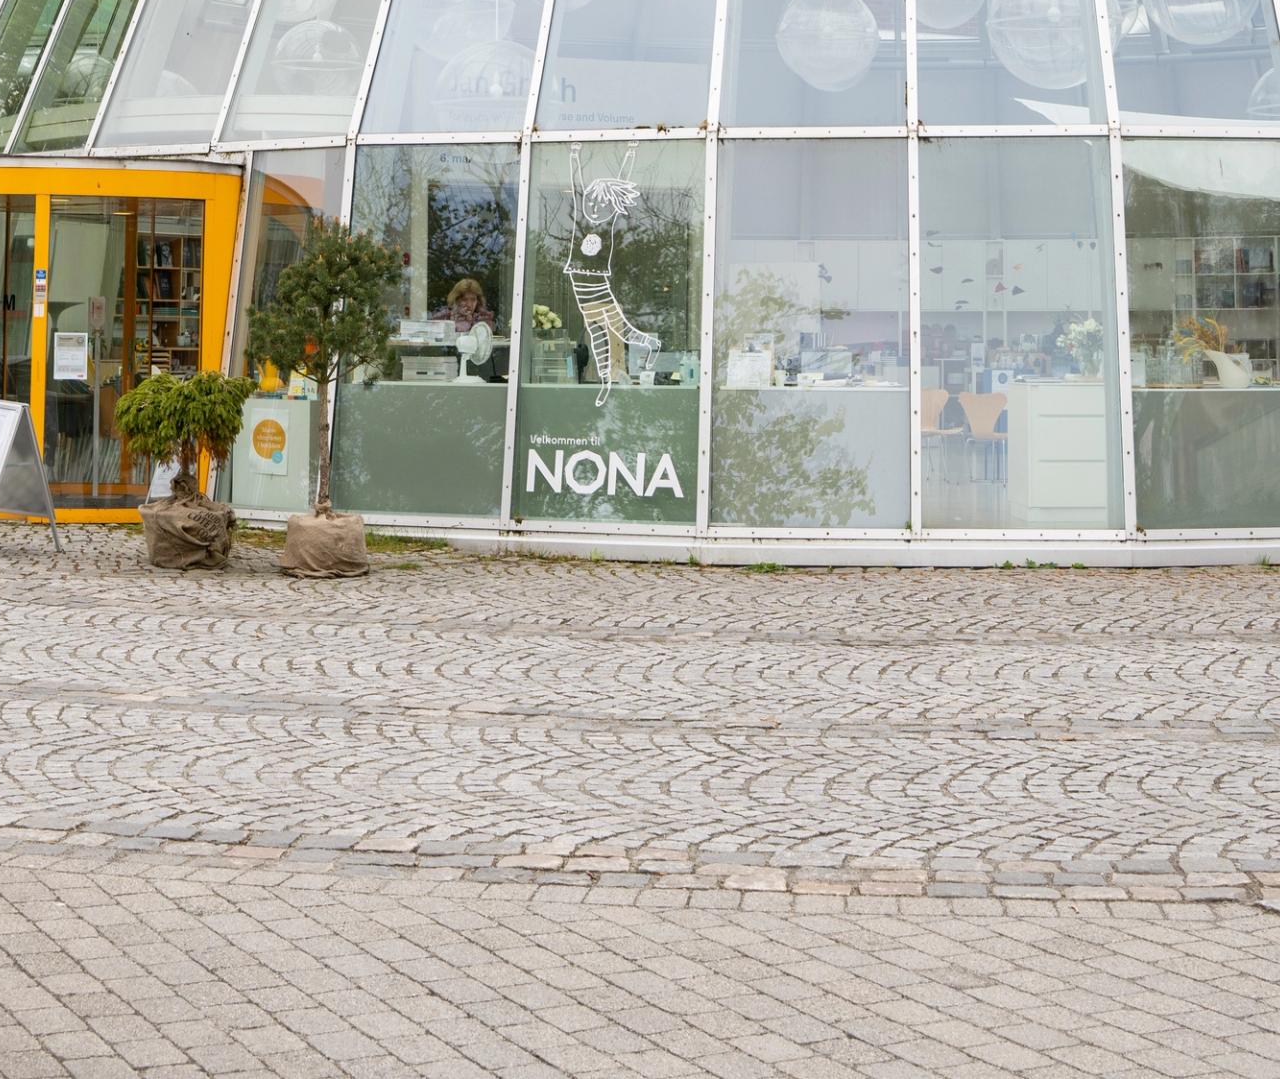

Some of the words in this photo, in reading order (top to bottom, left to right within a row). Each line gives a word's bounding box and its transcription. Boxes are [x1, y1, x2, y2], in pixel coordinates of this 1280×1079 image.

[529, 434, 588, 446] Velkommen
[590, 436, 601, 446] til
[526, 448, 684, 498] NONA
